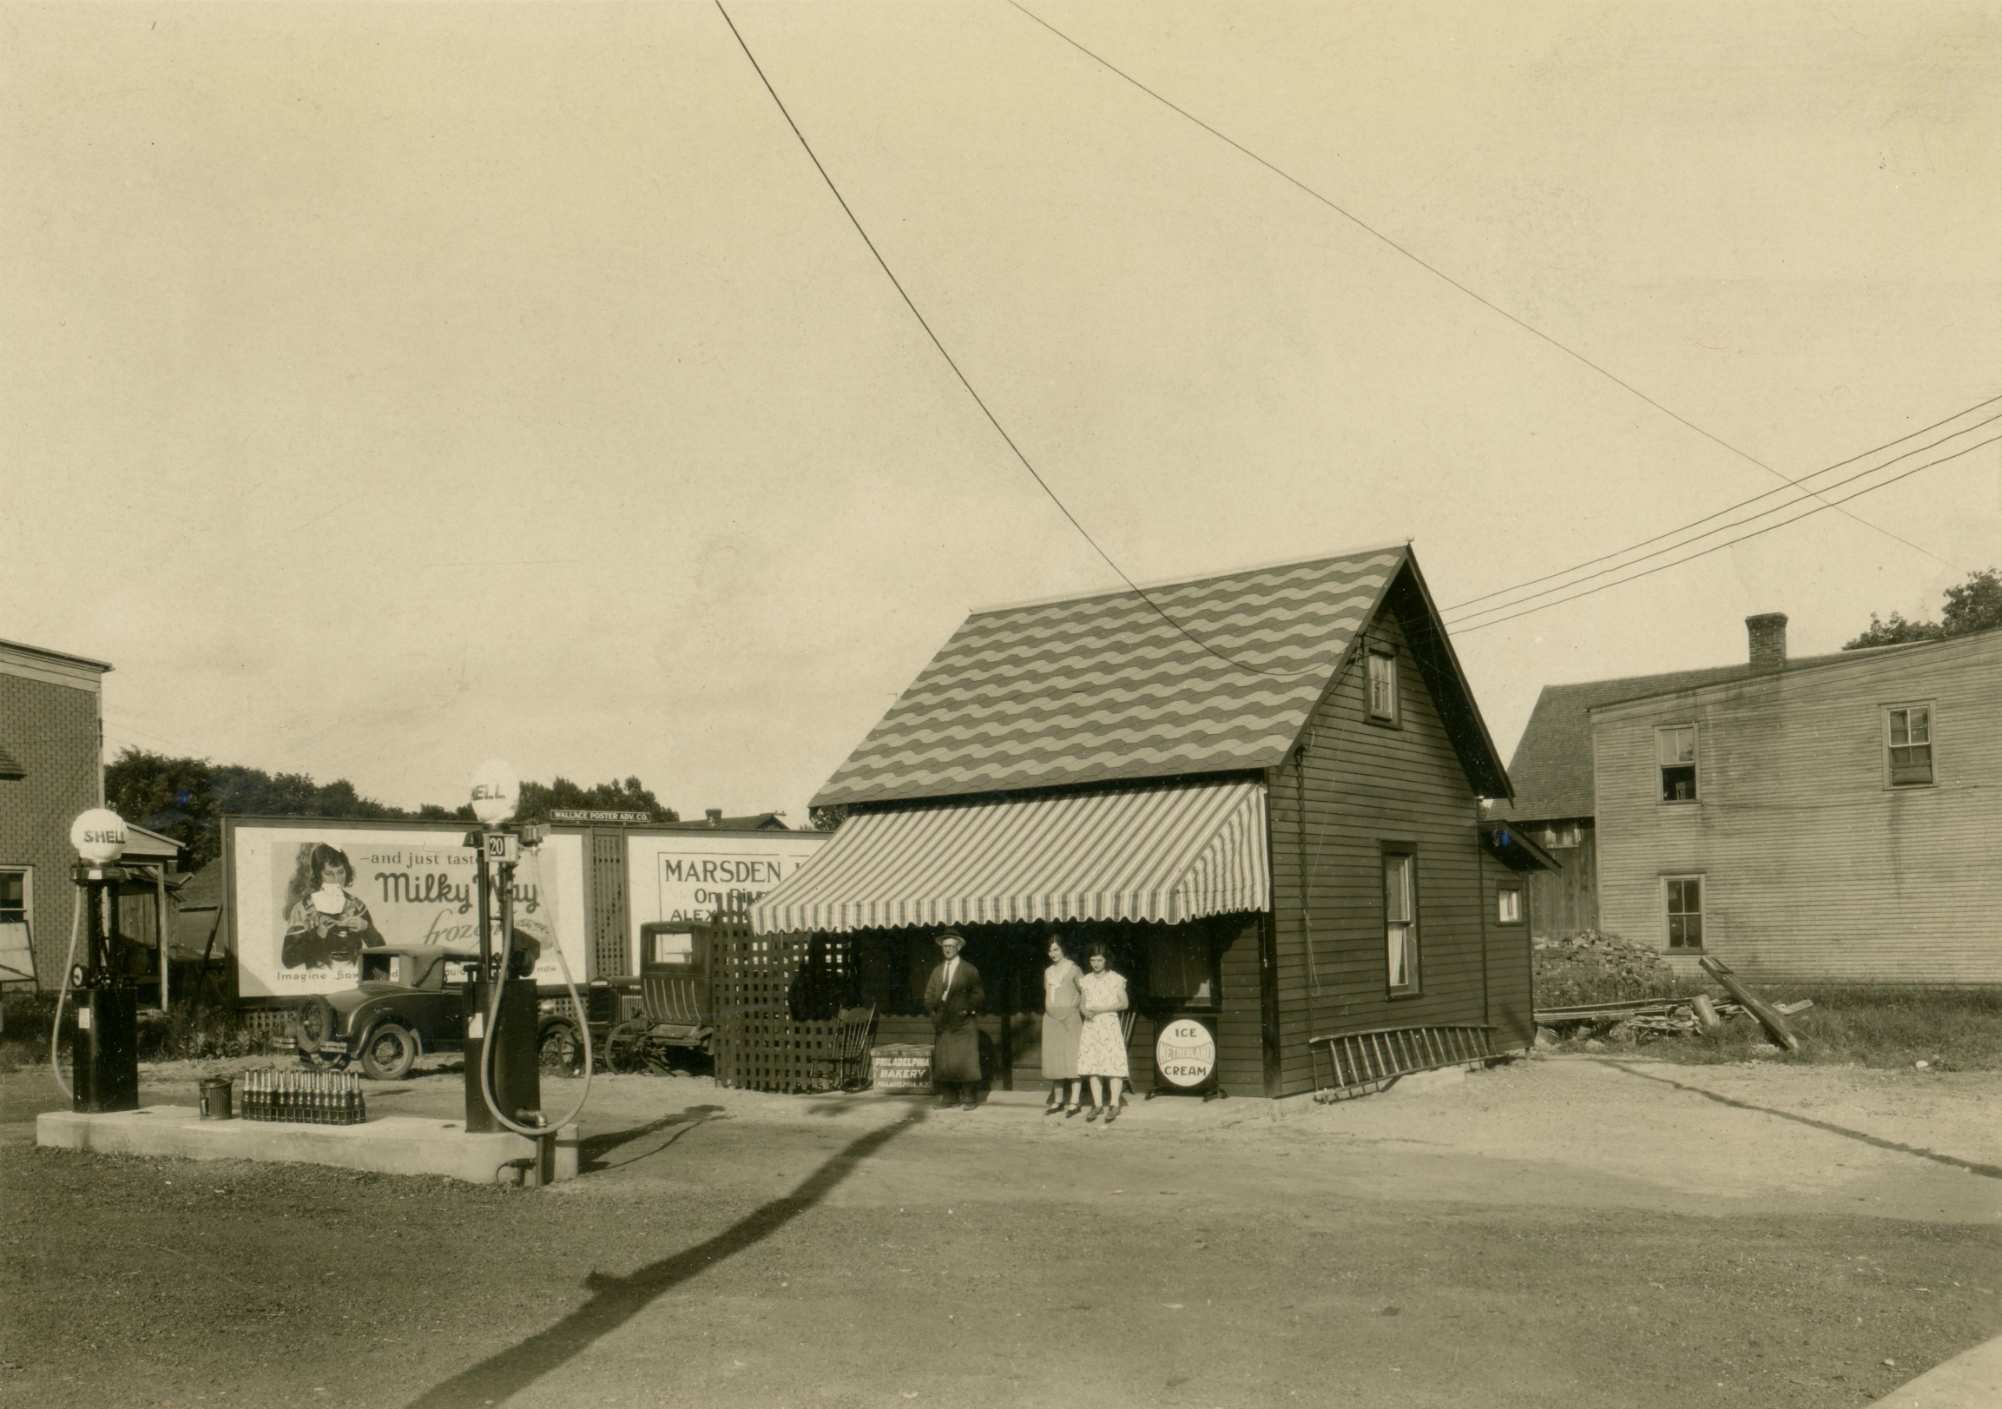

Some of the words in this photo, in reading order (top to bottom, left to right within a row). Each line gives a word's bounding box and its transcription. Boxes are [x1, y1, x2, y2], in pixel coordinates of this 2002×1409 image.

[554, 811, 588, 819] WALLACE
[590, 812, 618, 820] POSTER
[636, 813, 650, 821] CO.
[83, 830, 126, 844] SHELL
[489, 837, 503, 855] 20
[406, 852, 440, 869] just
[447, 855, 479, 865] tast
[664, 859, 781, 883] MARSDEN
[374, 872, 473, 915] Milky
[277, 971, 327, 982] Imagine
[1175, 1028, 1197, 1037] ICE
[1159, 1041, 1213, 1065] NETHERLAND
[875, 1057, 930, 1067] PHILADELPHIA
[880, 1069, 926, 1079] BAKERY
[1164, 1066, 1206, 1076] CREAM
